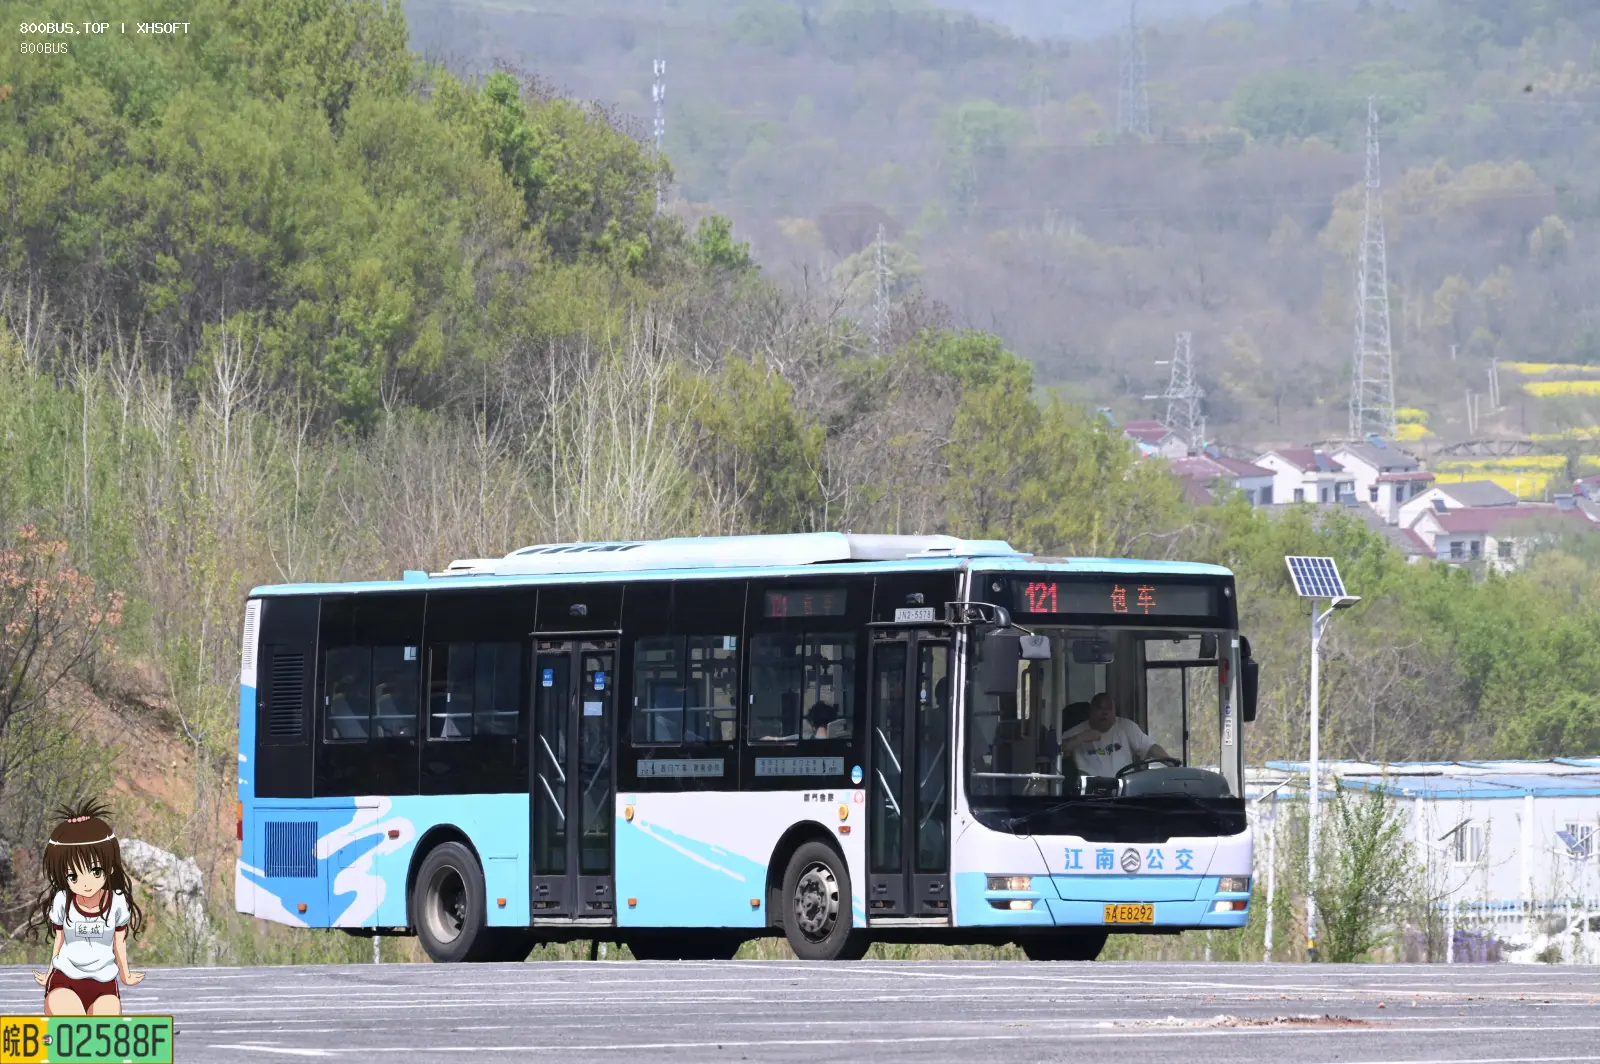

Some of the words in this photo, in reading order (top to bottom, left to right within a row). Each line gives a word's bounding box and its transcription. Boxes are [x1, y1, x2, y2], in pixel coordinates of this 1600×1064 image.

[1024, 581, 1058, 614] 121
[1064, 847, 1115, 871] 江南
[1146, 847, 1195, 871] 公交
